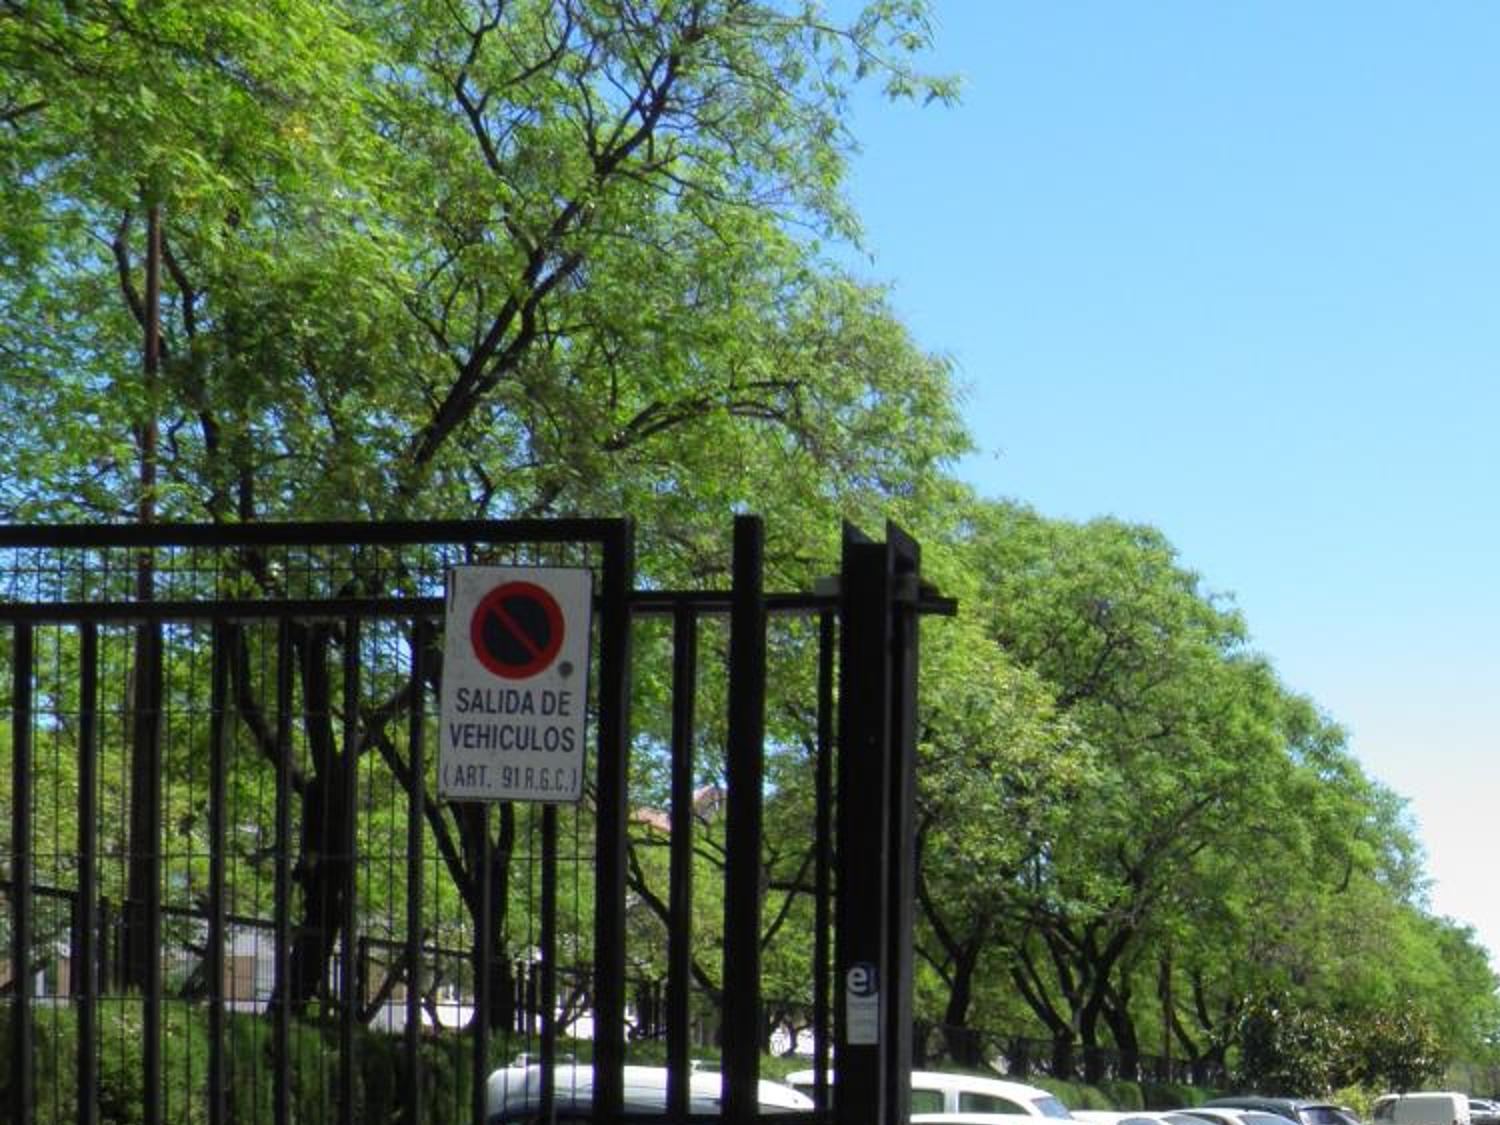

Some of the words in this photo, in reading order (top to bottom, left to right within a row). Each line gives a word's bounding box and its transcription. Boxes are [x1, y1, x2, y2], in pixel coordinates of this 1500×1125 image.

[456, 688, 534, 715] SALIDA
[541, 691, 571, 716] DE
[450, 724, 576, 752] VEHICULOS
